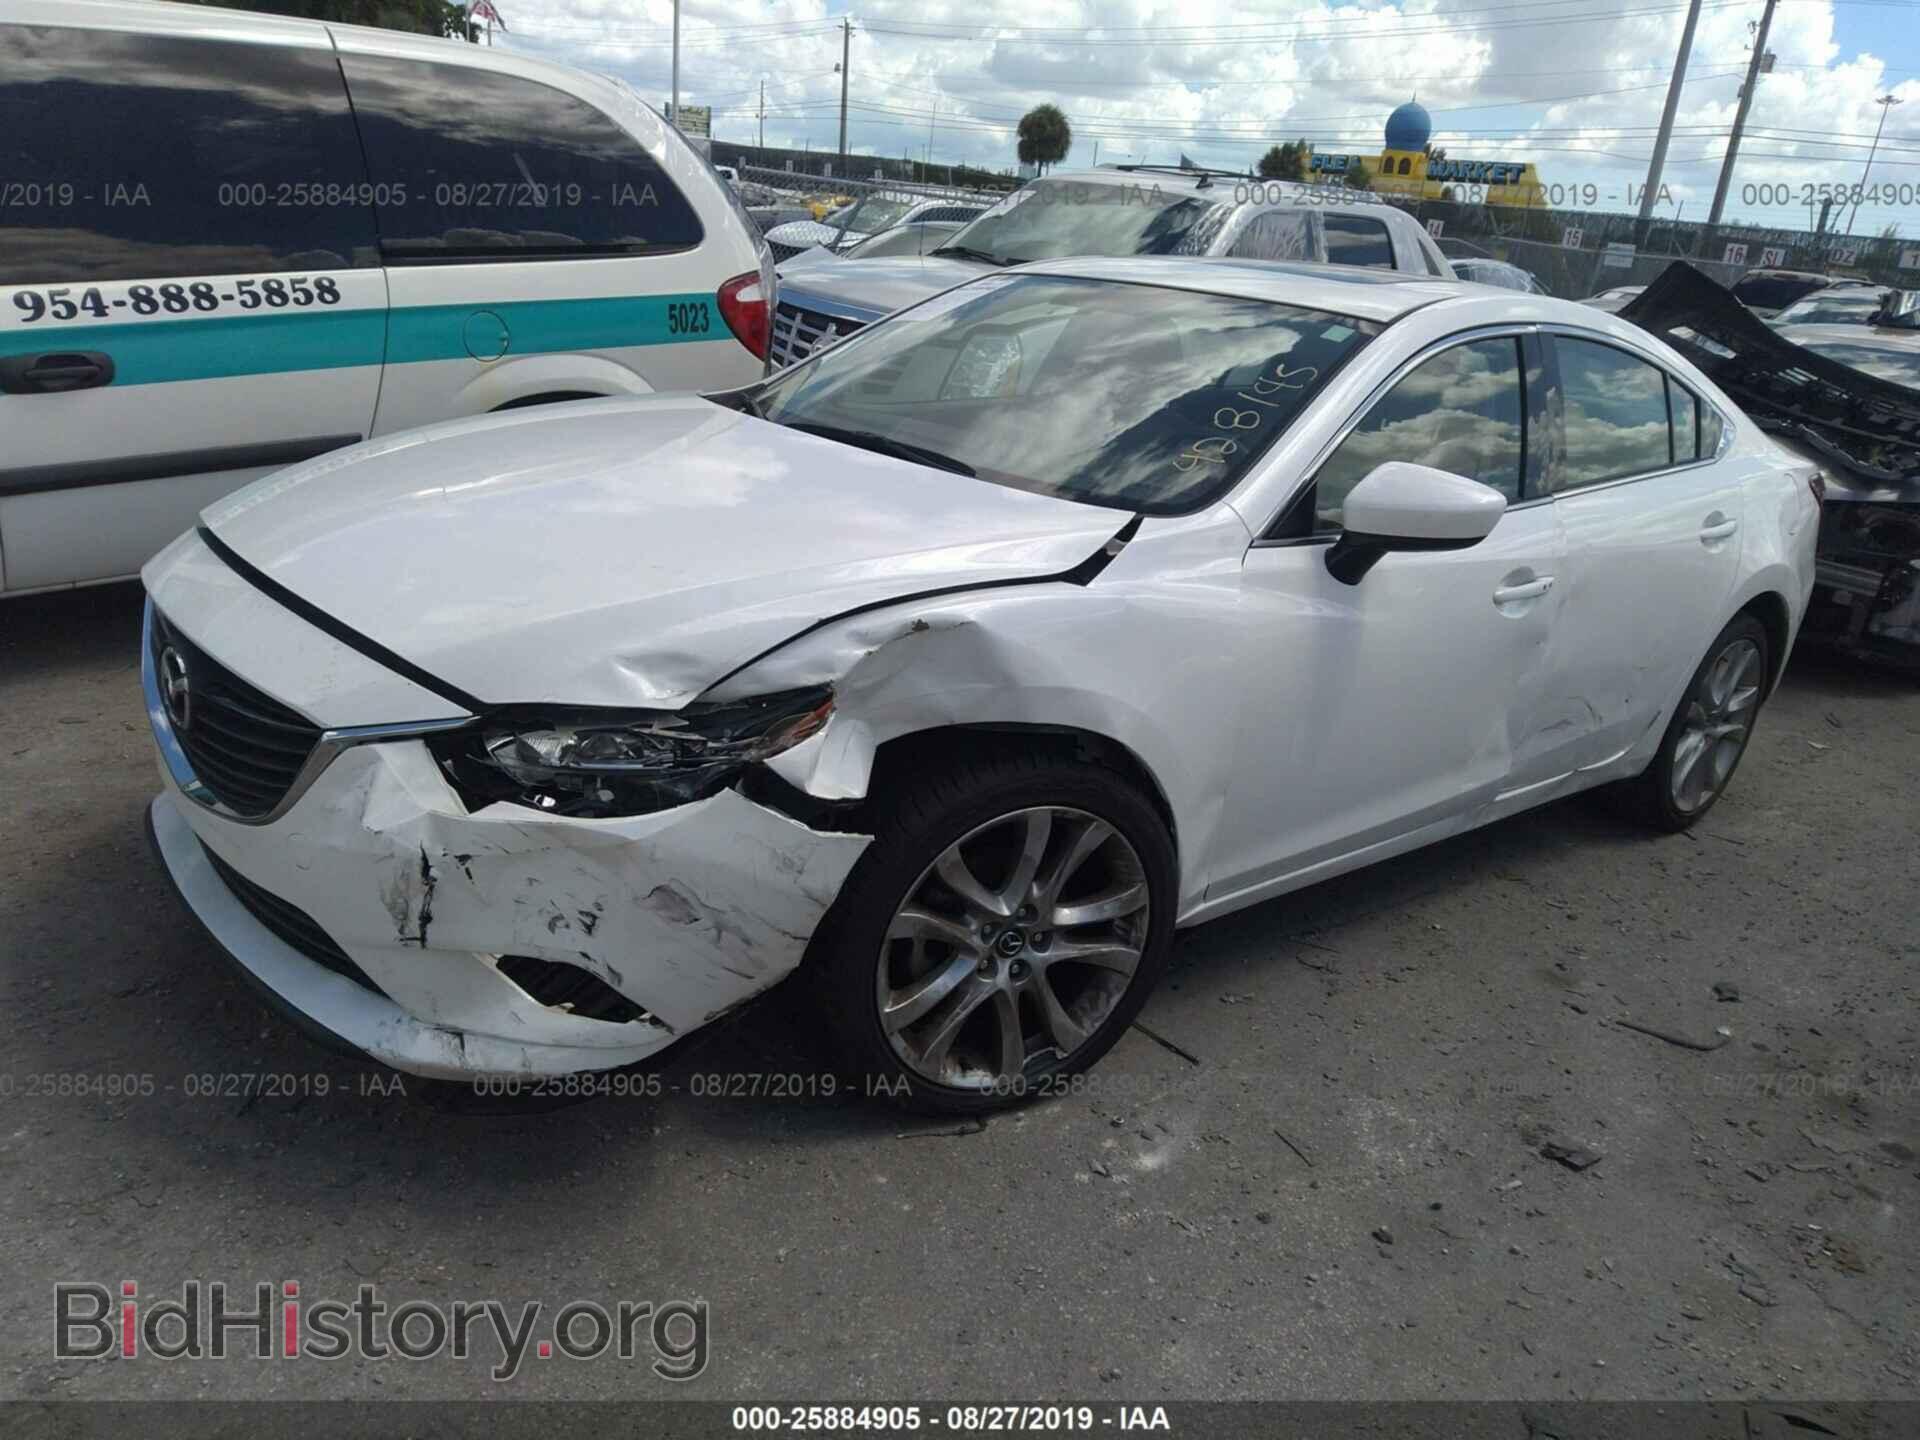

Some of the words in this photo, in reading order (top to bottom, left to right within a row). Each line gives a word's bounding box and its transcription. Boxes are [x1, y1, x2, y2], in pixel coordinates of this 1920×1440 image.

[1427, 159, 1525, 185] MARKET
[1566, 229, 1580, 247] 15
[1728, 246, 1744, 264] 16
[13, 276, 340, 322] 954-888-5858
[668, 302, 709, 334] 5023
